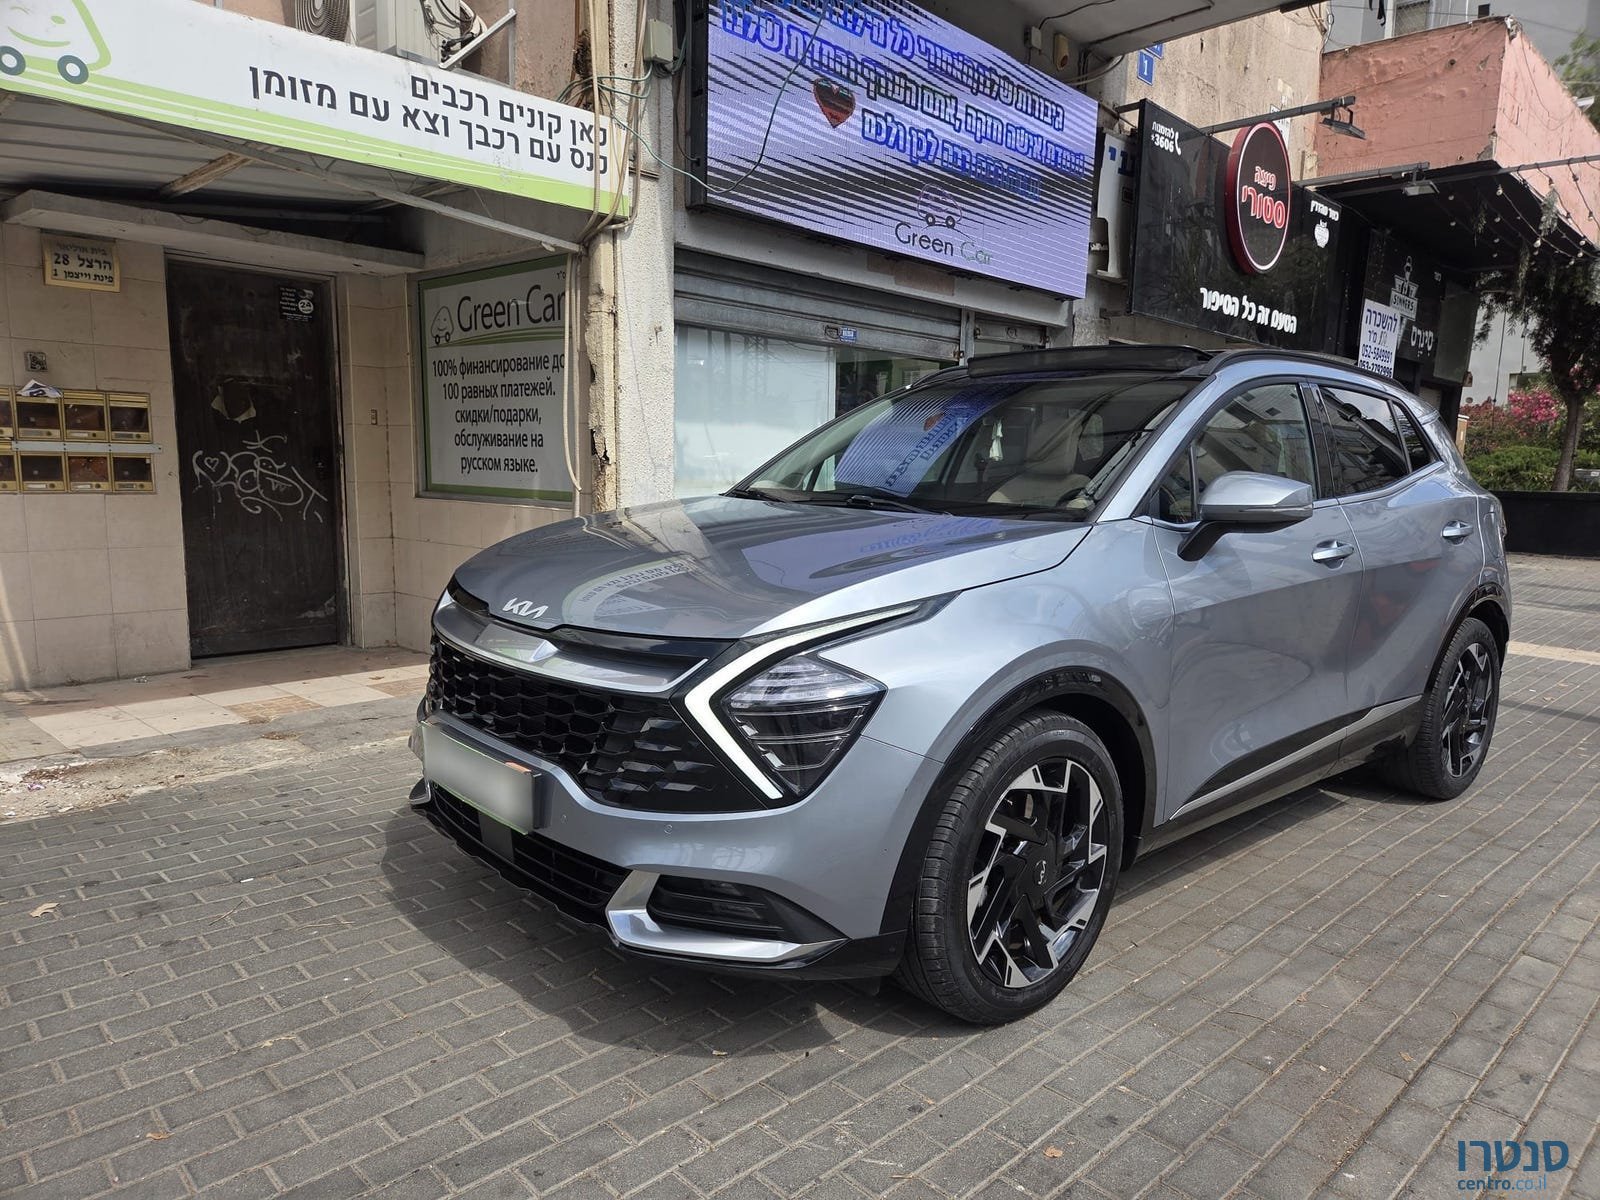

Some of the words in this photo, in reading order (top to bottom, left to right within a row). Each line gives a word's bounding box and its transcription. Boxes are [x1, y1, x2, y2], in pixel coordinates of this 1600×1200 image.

[249, 66, 337, 110] מזומן
[411, 75, 489, 116] רכבים
[350, 91, 390, 122] עם
[500, 100, 562, 139] קונים
[402, 105, 449, 137] וצא
[965, 103, 1003, 145] חזקה
[459, 120, 519, 154] רכבך
[530, 137, 561, 163] עם
[1254, 166, 1277, 191] פיצה
[1241, 185, 1286, 229] סטורי
[895, 221, 954, 257] Green
[960, 241, 991, 265] Car
[53, 252, 70, 266] 28
[77, 254, 112, 271] הרצל
[53, 268, 58, 277] 1
[93, 273, 114, 283] פינת
[457, 295, 520, 332] Green
[526, 284, 566, 324] Car
[1200, 287, 1240, 317] הסיפור
[1241, 295, 1257, 322] כל
[1257, 305, 1271, 326] זה
[1270, 310, 1297, 334] הטעם
[1365, 308, 1398, 333] להשכרה
[432, 358, 458, 378] 100%
[459, 354, 550, 380] финансирование
[443, 383, 459, 400] 100
[461, 383, 499, 403] равных
[500, 376, 556, 398] платежей.
[455, 404, 542, 427] скидки/подарки,
[454, 428, 528, 451] обслуживание
[530, 433, 544, 448] на
[460, 455, 502, 474] русском
[503, 457, 538, 473] языке.
